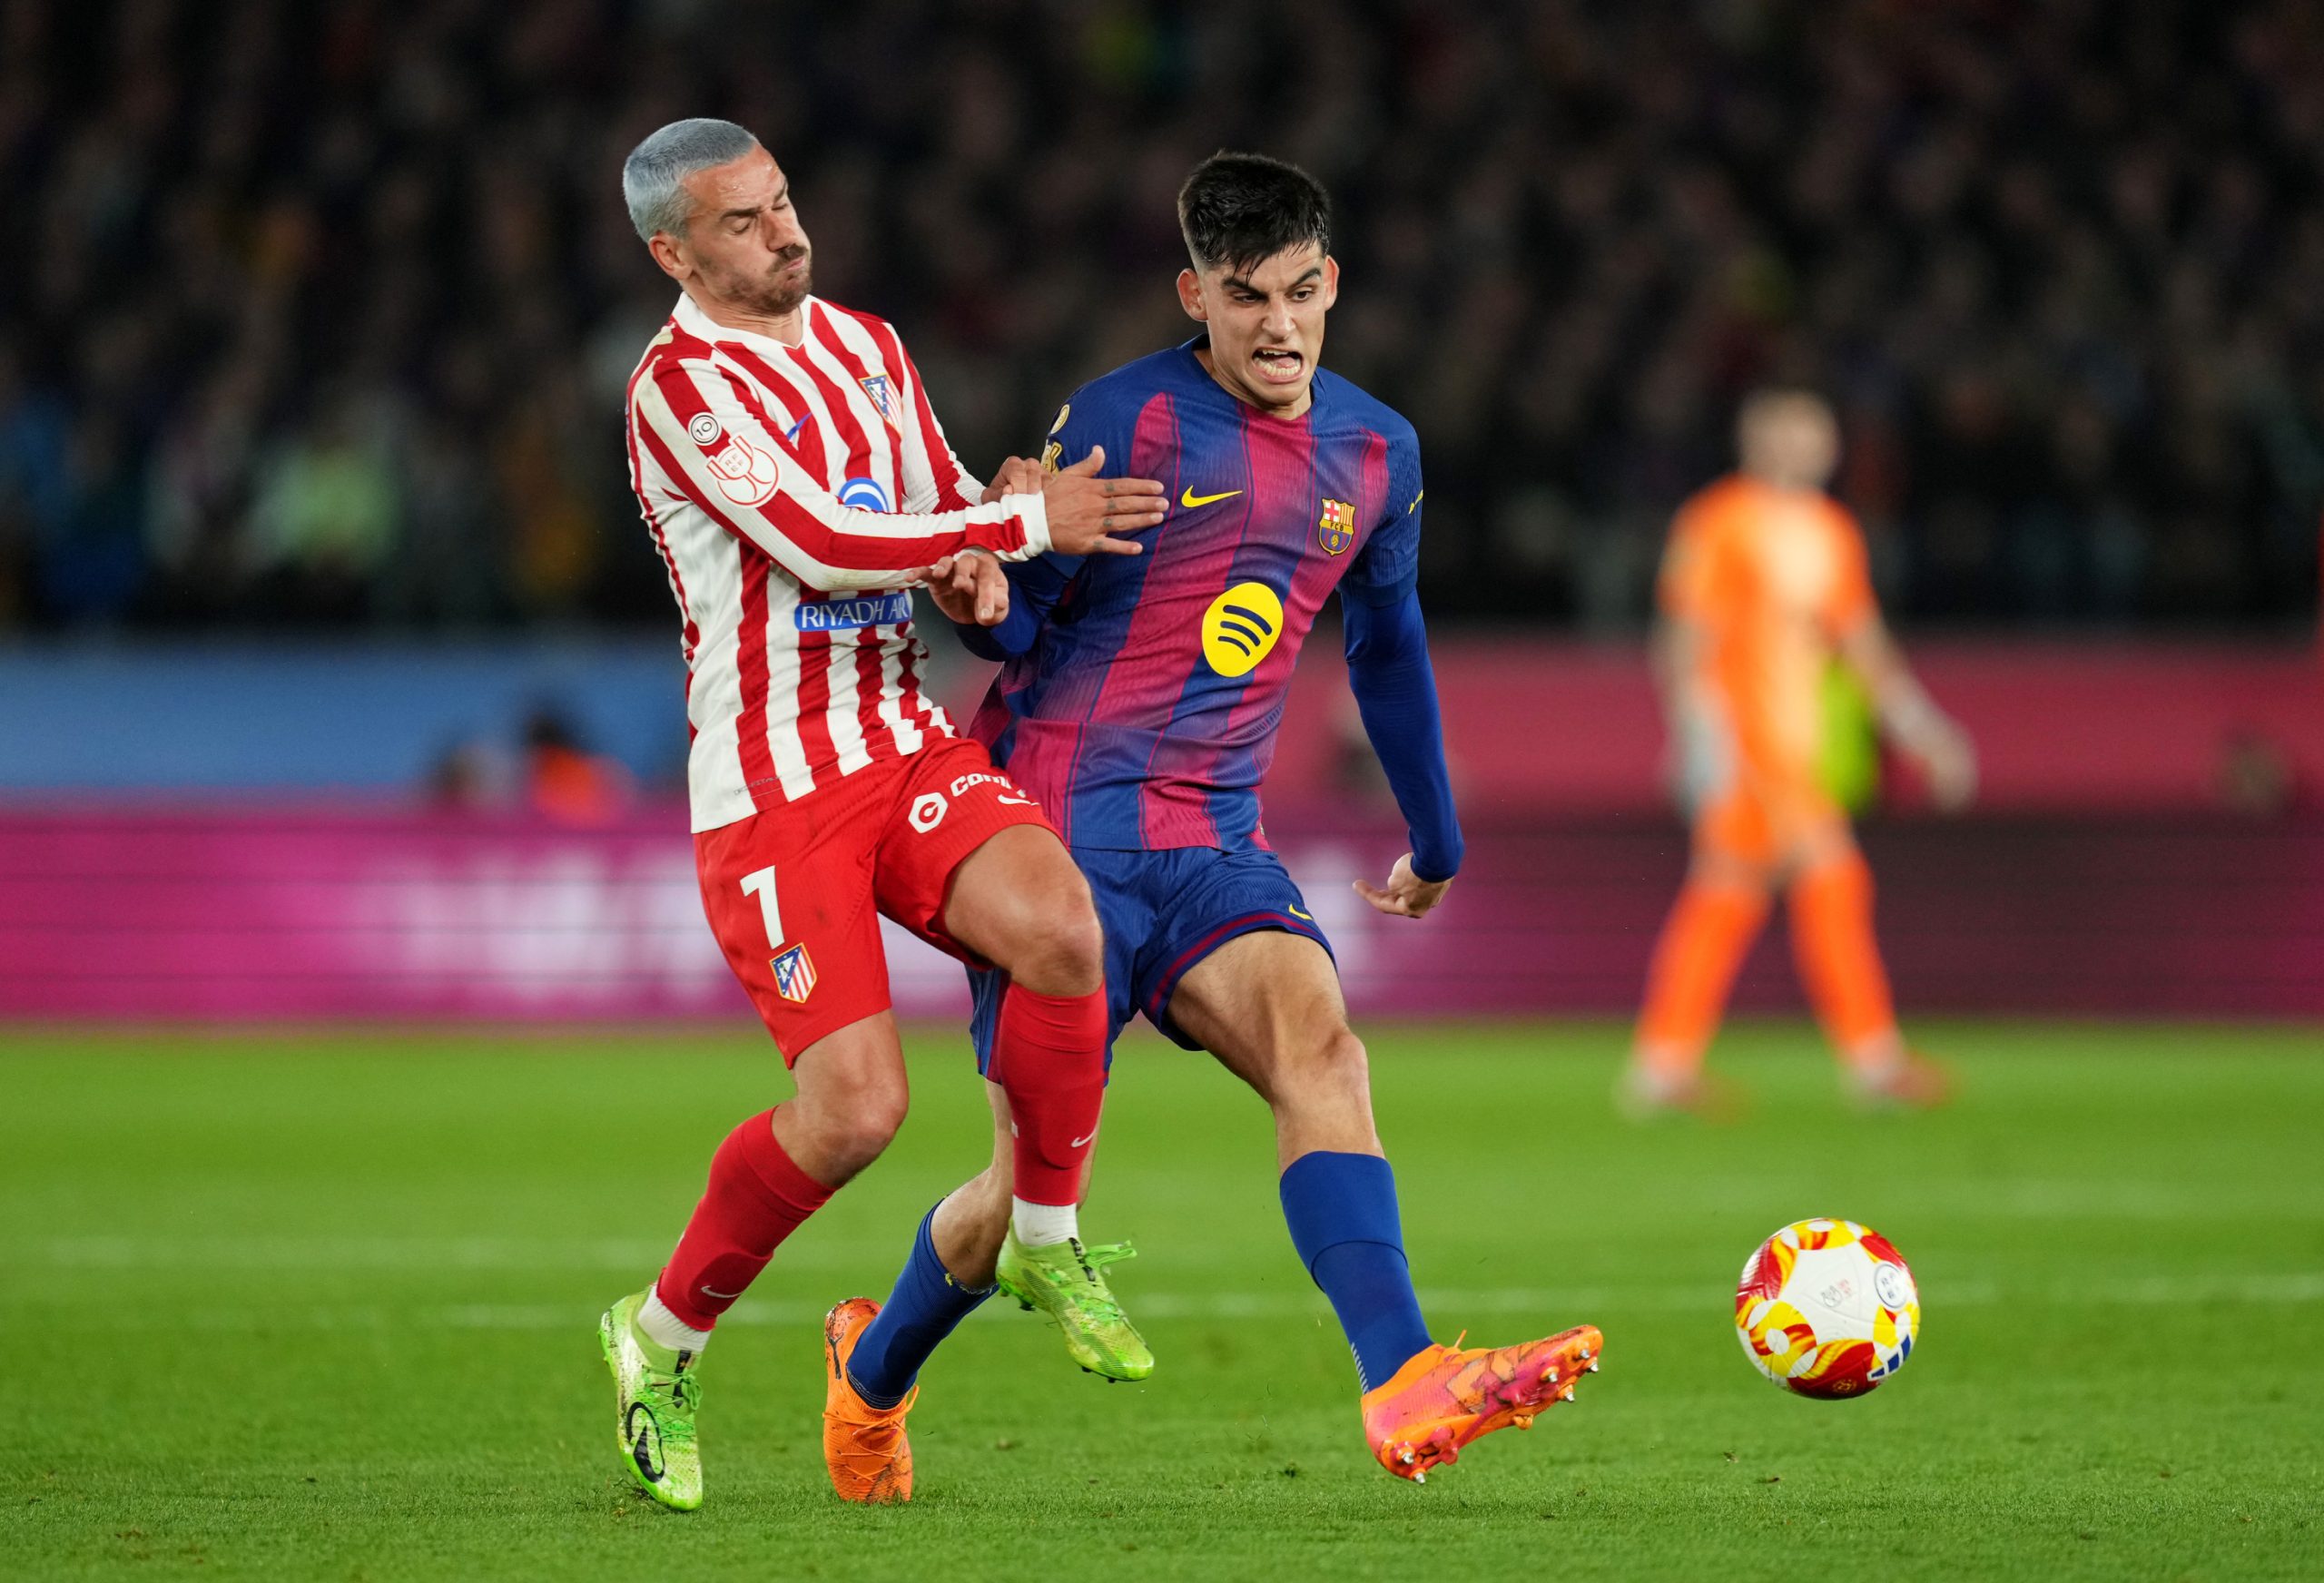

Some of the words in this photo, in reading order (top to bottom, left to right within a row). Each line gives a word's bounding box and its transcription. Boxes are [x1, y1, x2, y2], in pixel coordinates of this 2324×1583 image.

[695, 421, 713, 437] 10
[1330, 522, 1344, 532] FCB
[802, 599, 886, 628] RIYADH
